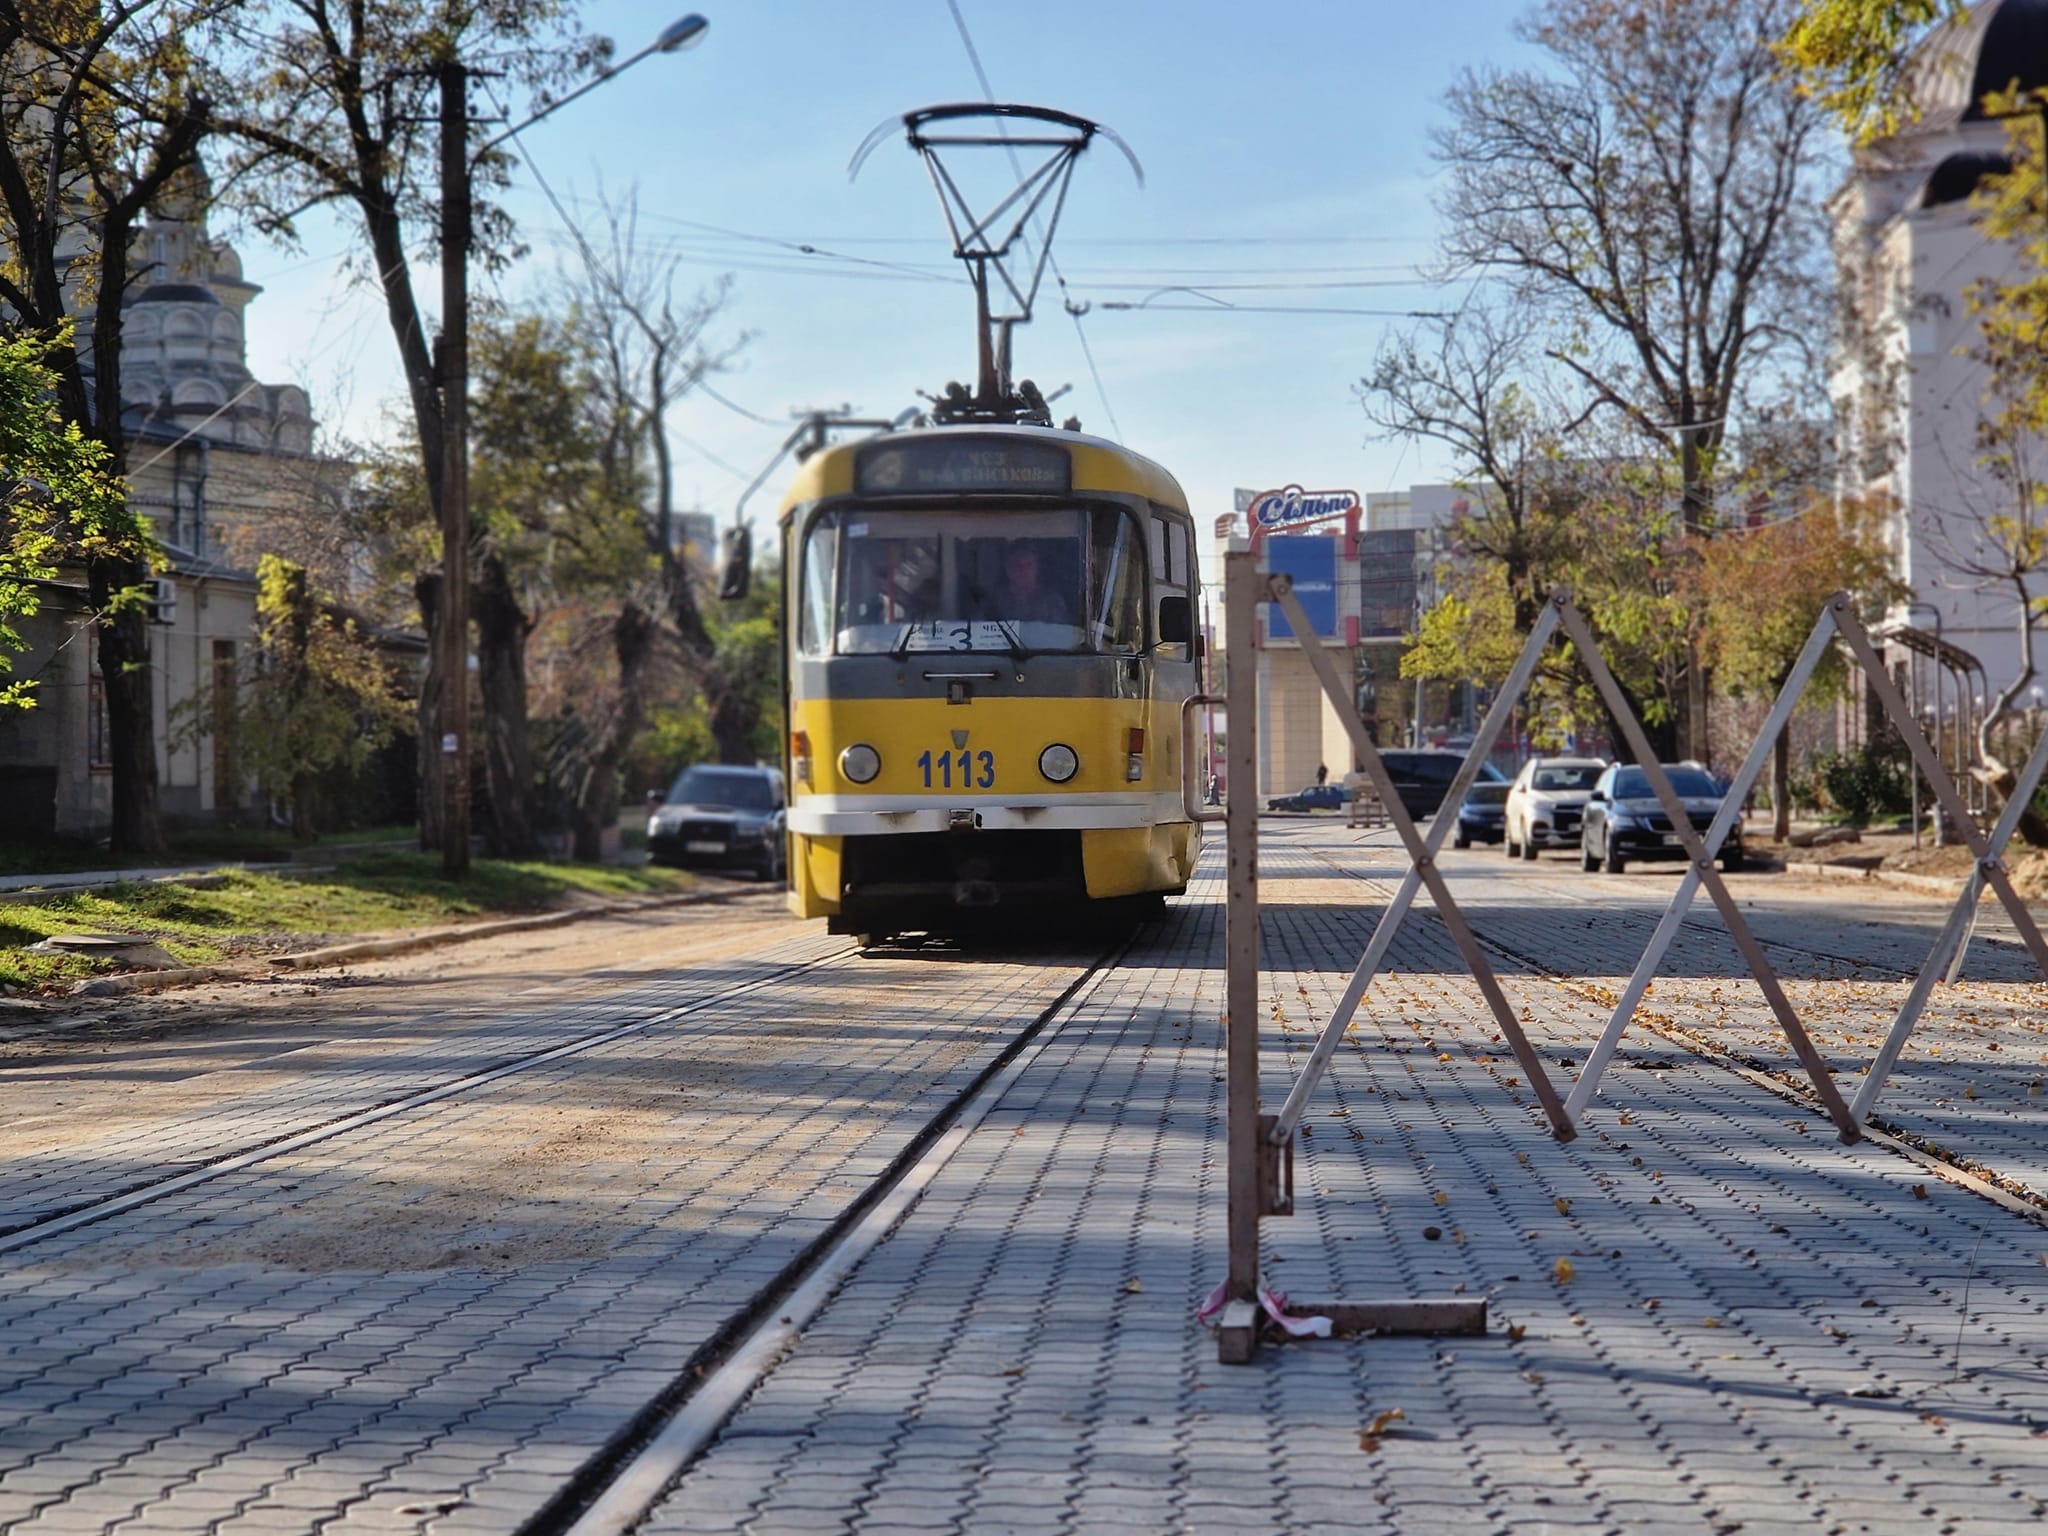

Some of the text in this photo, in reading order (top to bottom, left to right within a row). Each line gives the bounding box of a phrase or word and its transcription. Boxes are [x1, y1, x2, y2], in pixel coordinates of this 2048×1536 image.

[1258, 493, 1353, 524] Сільпо
[949, 628, 973, 650] 3
[917, 750, 995, 788] 1113
